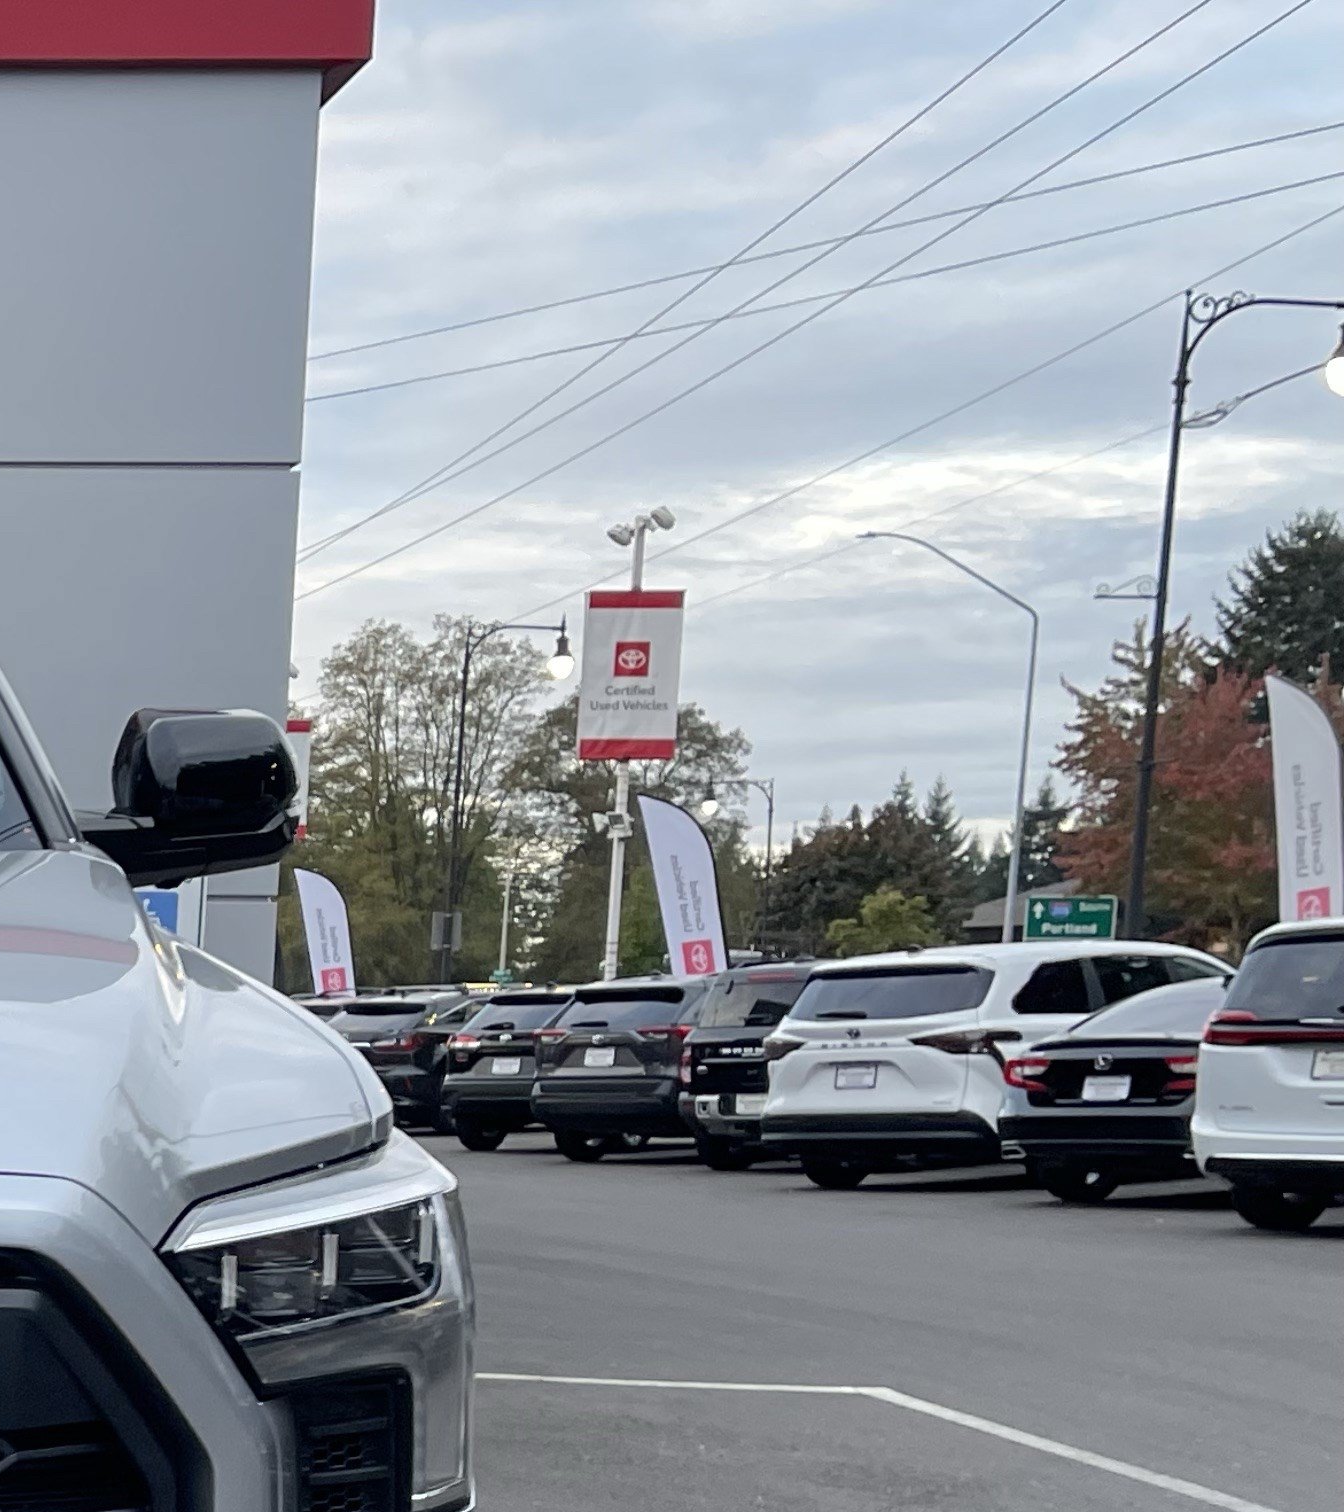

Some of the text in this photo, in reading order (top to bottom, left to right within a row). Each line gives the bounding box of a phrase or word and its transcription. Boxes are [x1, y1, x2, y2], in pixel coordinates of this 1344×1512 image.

[604, 685, 656, 696] Certified
[589, 700, 669, 711] Used Vehicles
